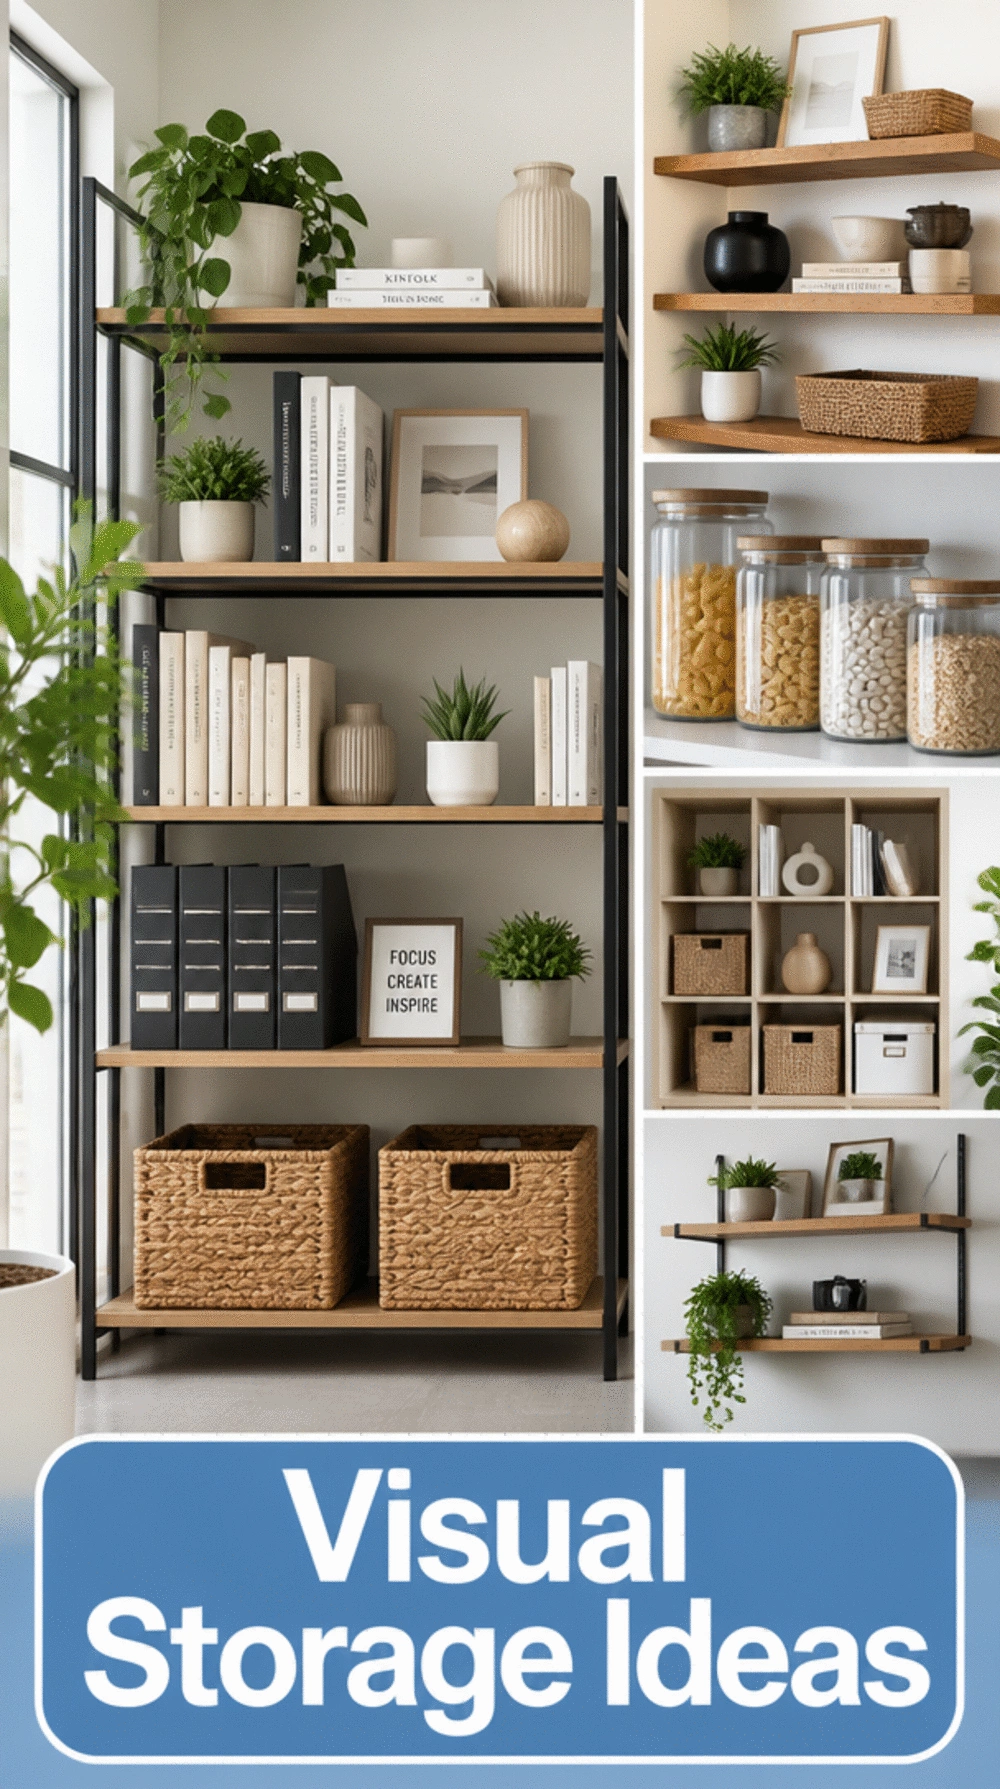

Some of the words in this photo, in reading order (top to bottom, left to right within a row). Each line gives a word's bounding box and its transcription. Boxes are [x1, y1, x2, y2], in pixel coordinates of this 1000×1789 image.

[390, 950, 436, 965] FOCUS
[388, 974, 437, 989] CREATE
[386, 998, 437, 1012] INSPIRE
